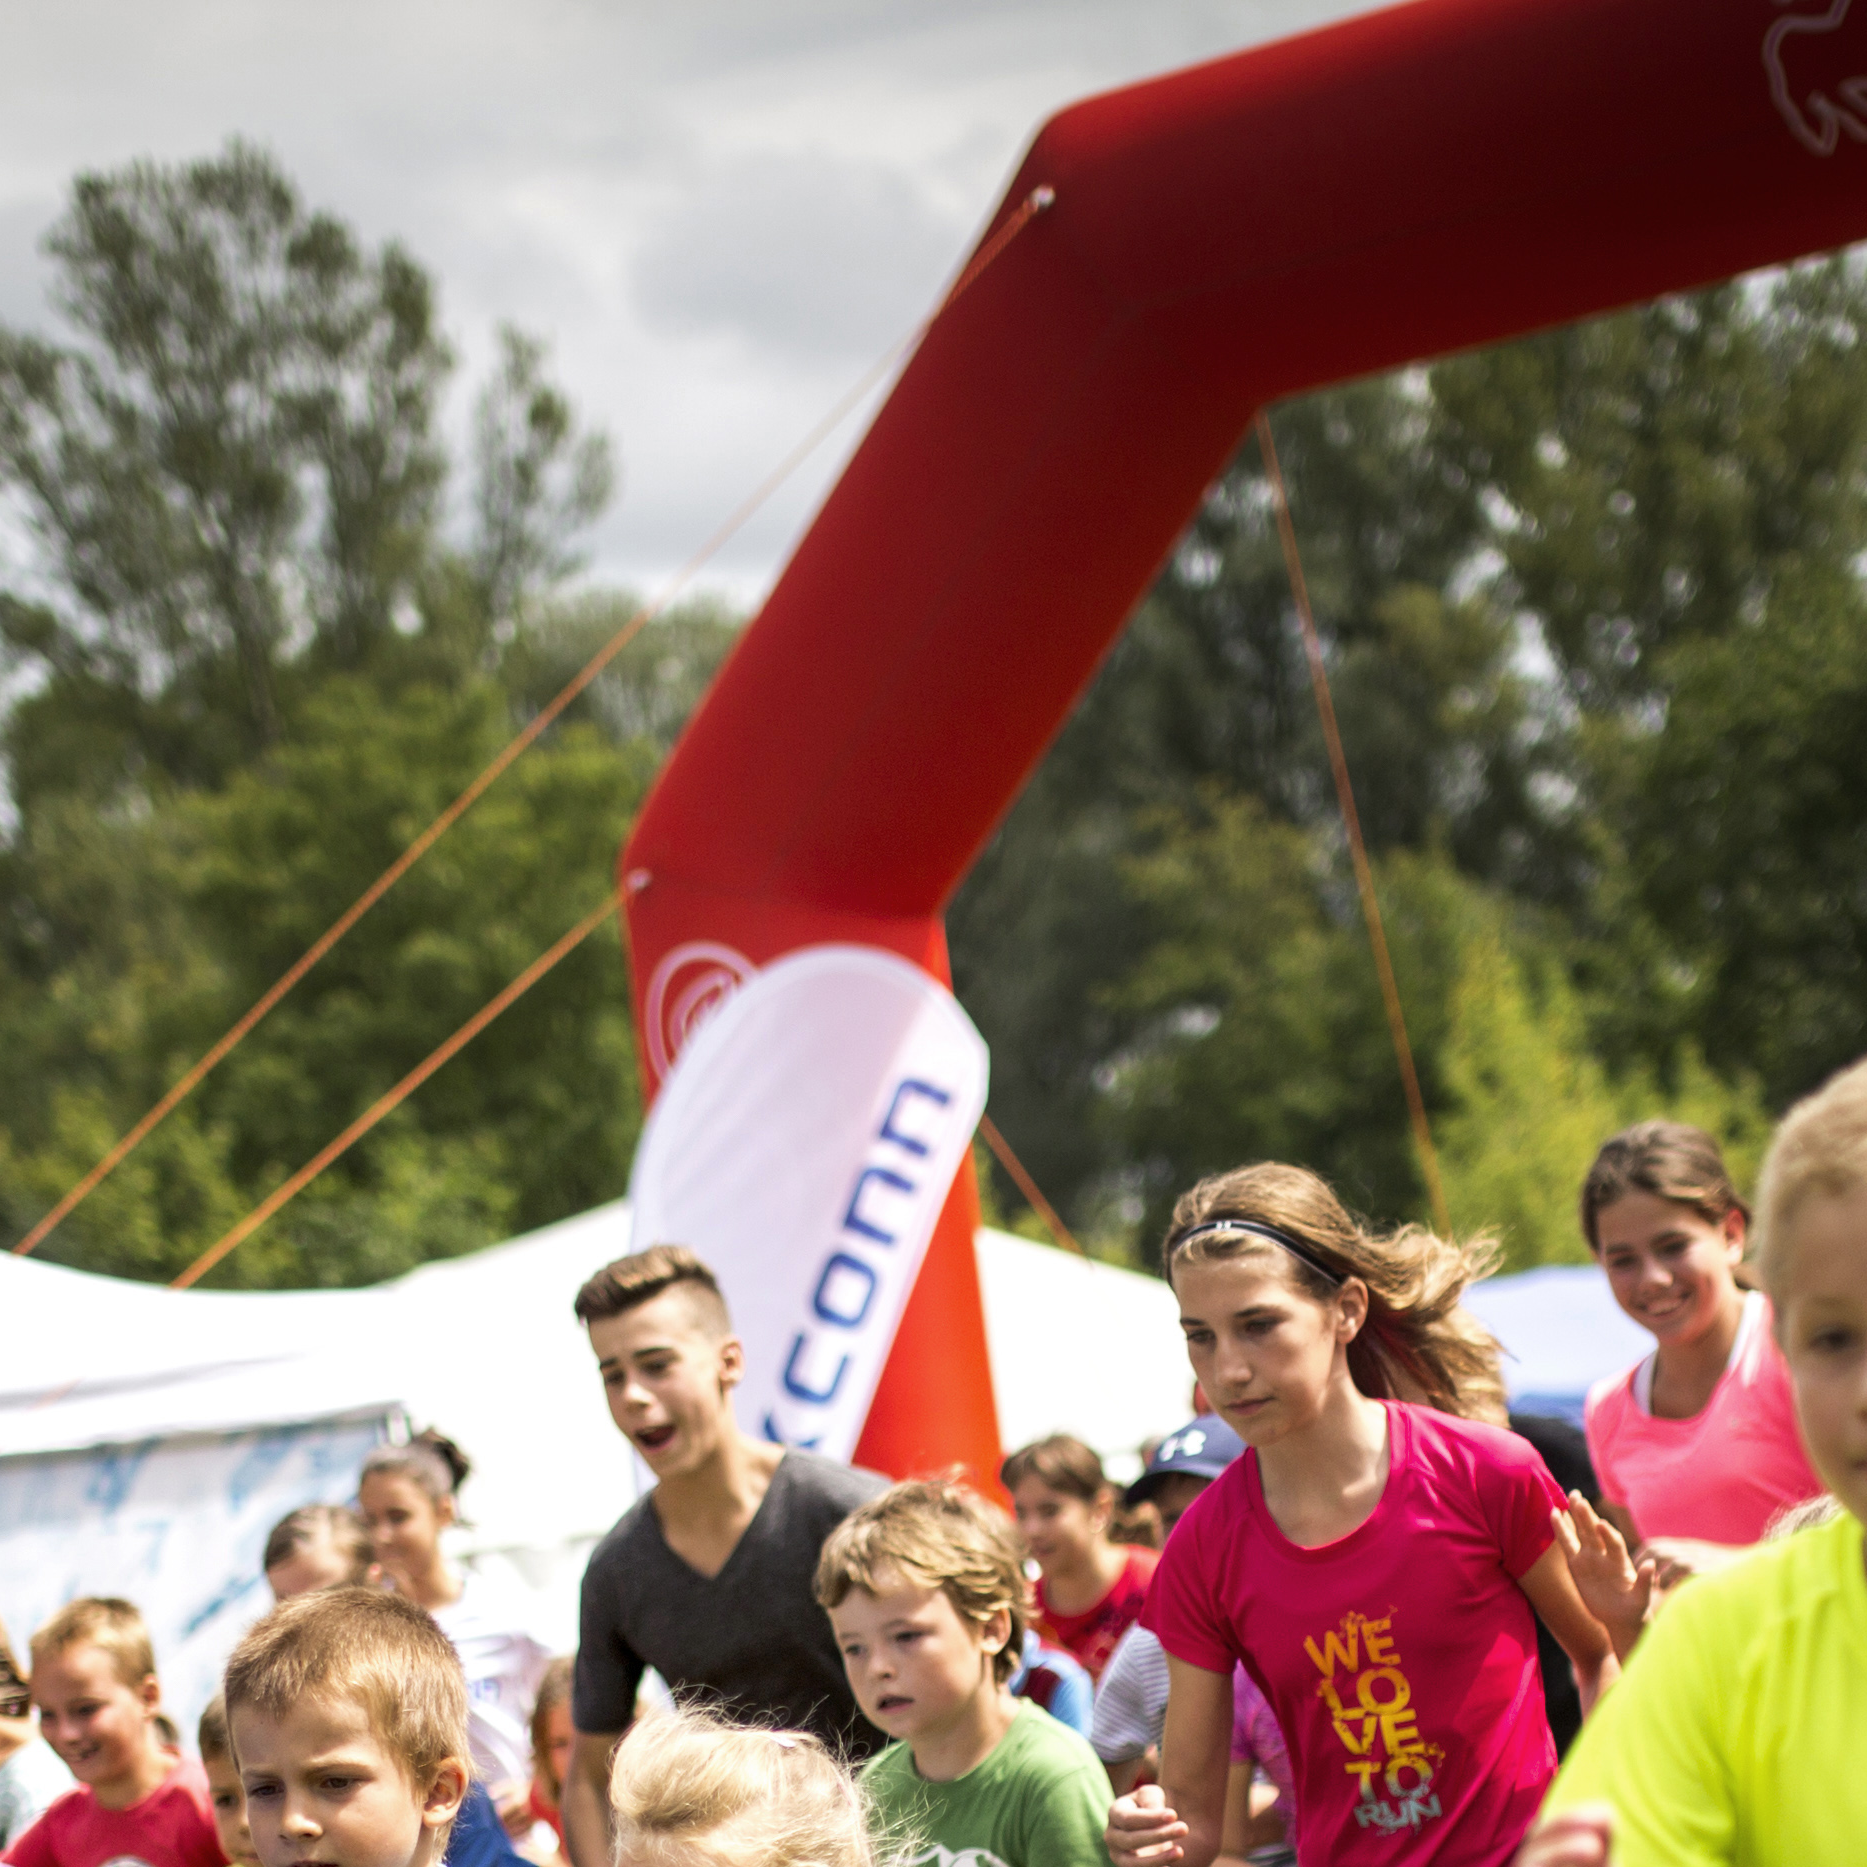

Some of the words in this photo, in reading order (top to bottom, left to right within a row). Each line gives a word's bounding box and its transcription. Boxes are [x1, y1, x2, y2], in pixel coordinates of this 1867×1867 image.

[761, 1078, 953, 1450] conn
[1303, 1615, 1401, 1679] WE
[1344, 1757, 1436, 1804] TO
[1355, 1793, 1443, 1832] RUN
